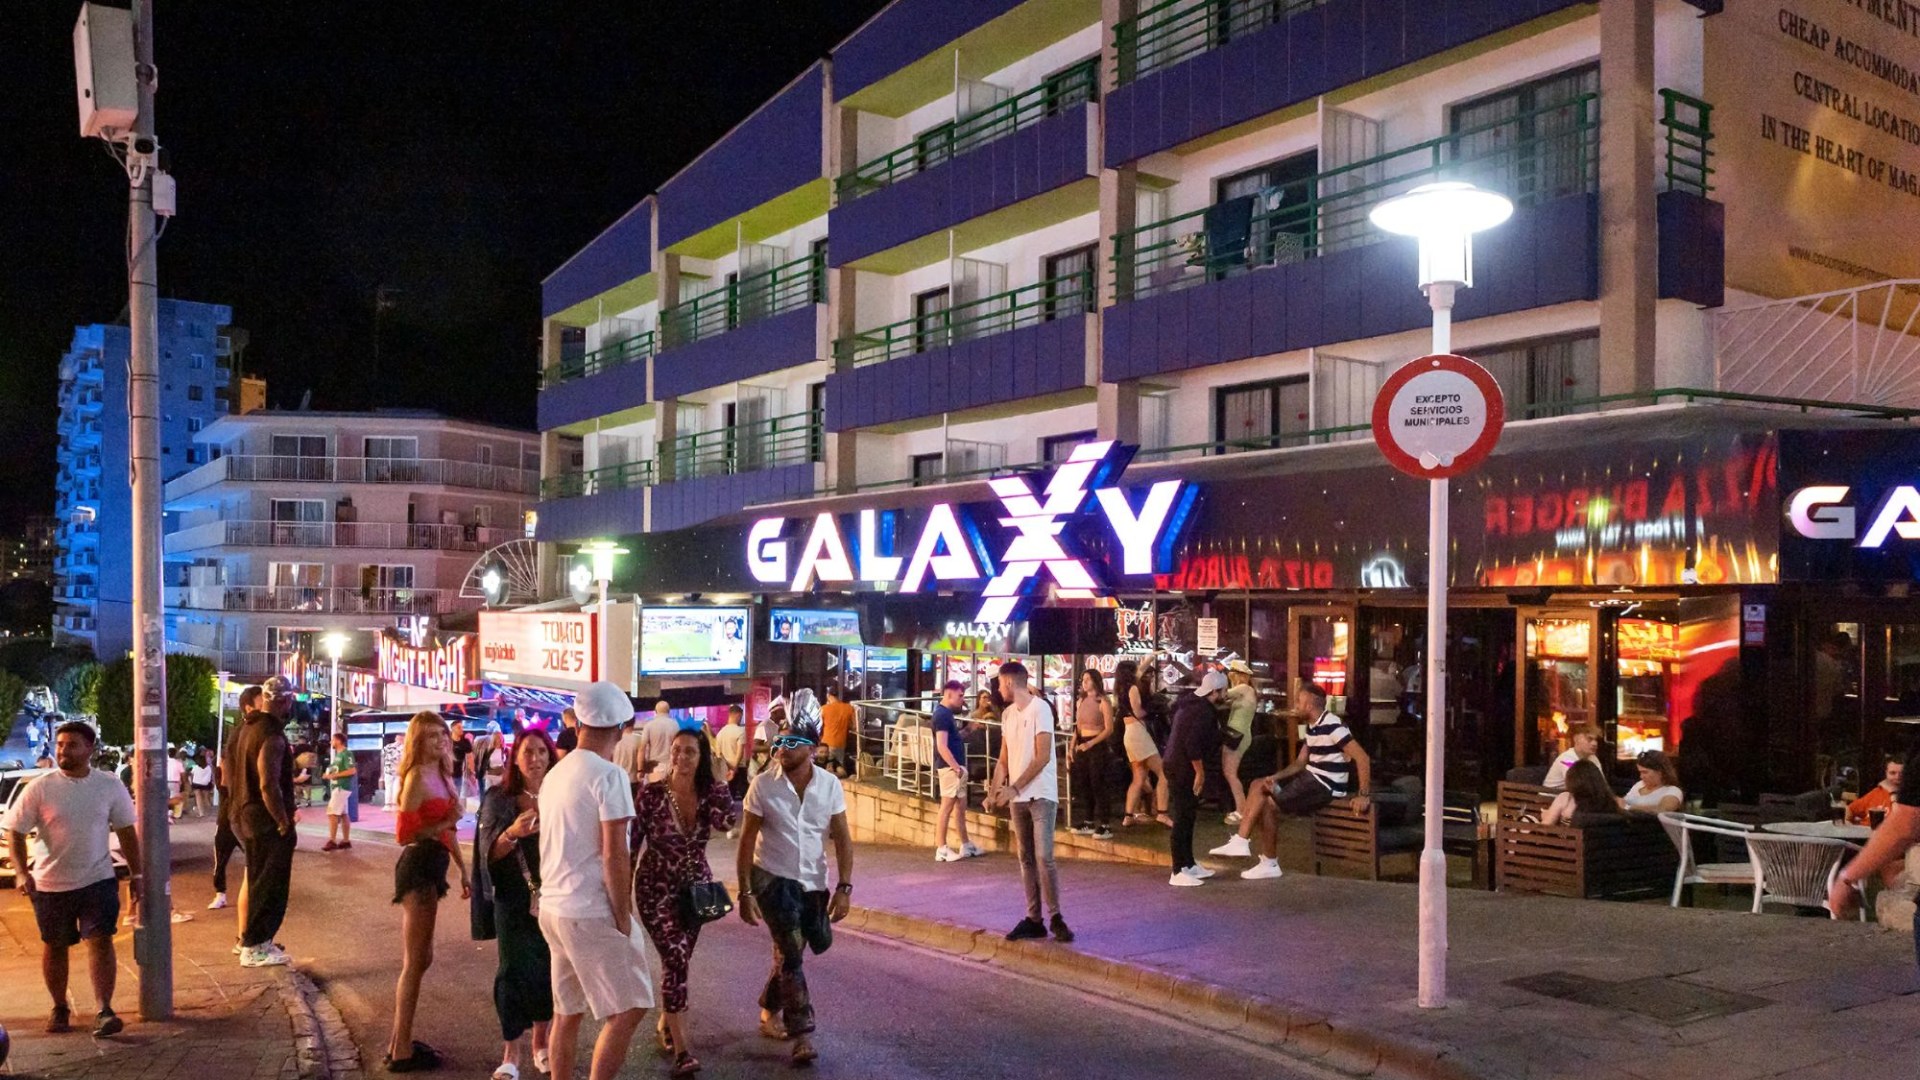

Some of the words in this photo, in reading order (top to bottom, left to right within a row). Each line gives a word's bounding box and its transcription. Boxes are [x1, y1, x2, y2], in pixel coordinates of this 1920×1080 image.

[1779, 8, 1830, 51] CHEAP
[1846, 0, 1920, 38] MENT
[1794, 71, 1861, 120] CENTRAL
[1761, 113, 1777, 140] IN
[1781, 121, 1811, 154] THE
[1815, 135, 1864, 175] HEART
[1868, 157, 1885, 182] OF
[1888, 164, 1920, 197] MAG
[1410, 405, 1463, 416] SERVICIOS
[1415, 393, 1461, 403] EXCEPTO
[1404, 416, 1470, 427] MUNICIPALES
[747, 440, 1182, 623] GALAXY
[946, 621, 1011, 644] GALAXY
[379, 630, 416, 685] NIGHT
[417, 634, 468, 694] FLIGHT
